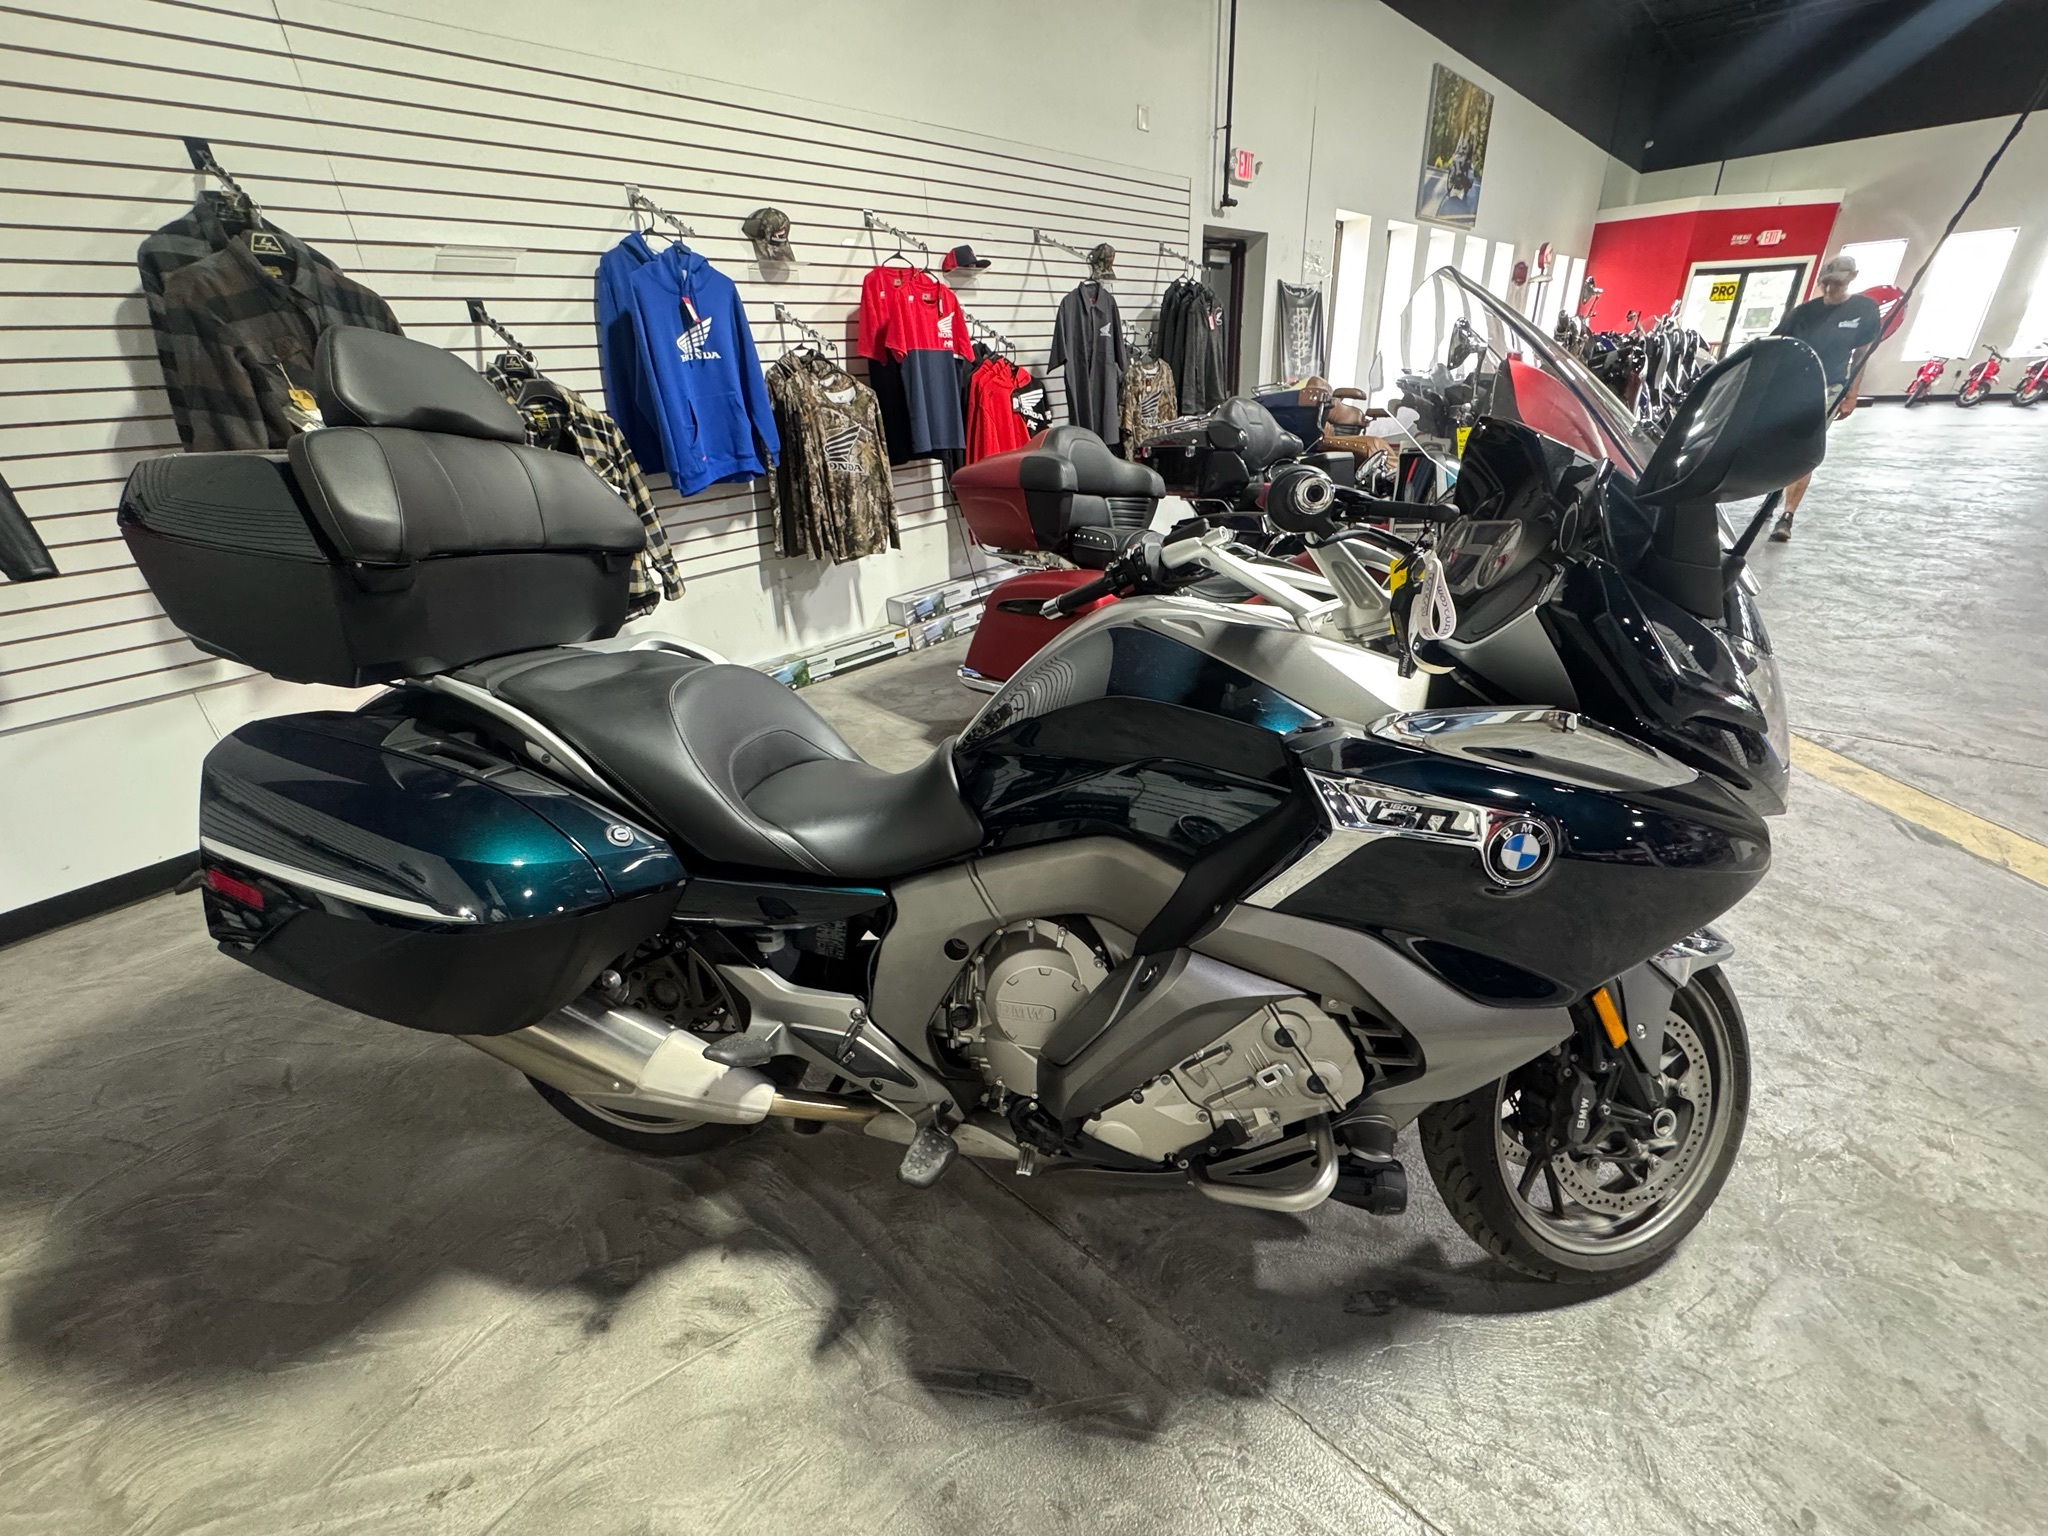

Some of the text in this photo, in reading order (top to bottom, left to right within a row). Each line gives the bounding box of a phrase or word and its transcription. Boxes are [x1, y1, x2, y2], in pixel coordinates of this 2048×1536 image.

[1238, 150, 1254, 180] EXIT
[1764, 231, 1780, 244] EXIT
[1710, 284, 1736, 297] PRO
[828, 462, 865, 473] ONDA
[1389, 802, 1418, 813] 1600
[1500, 822, 1550, 847] BMW
[999, 1004, 1045, 1020] BMW
[1576, 1097, 1590, 1129] BMW
